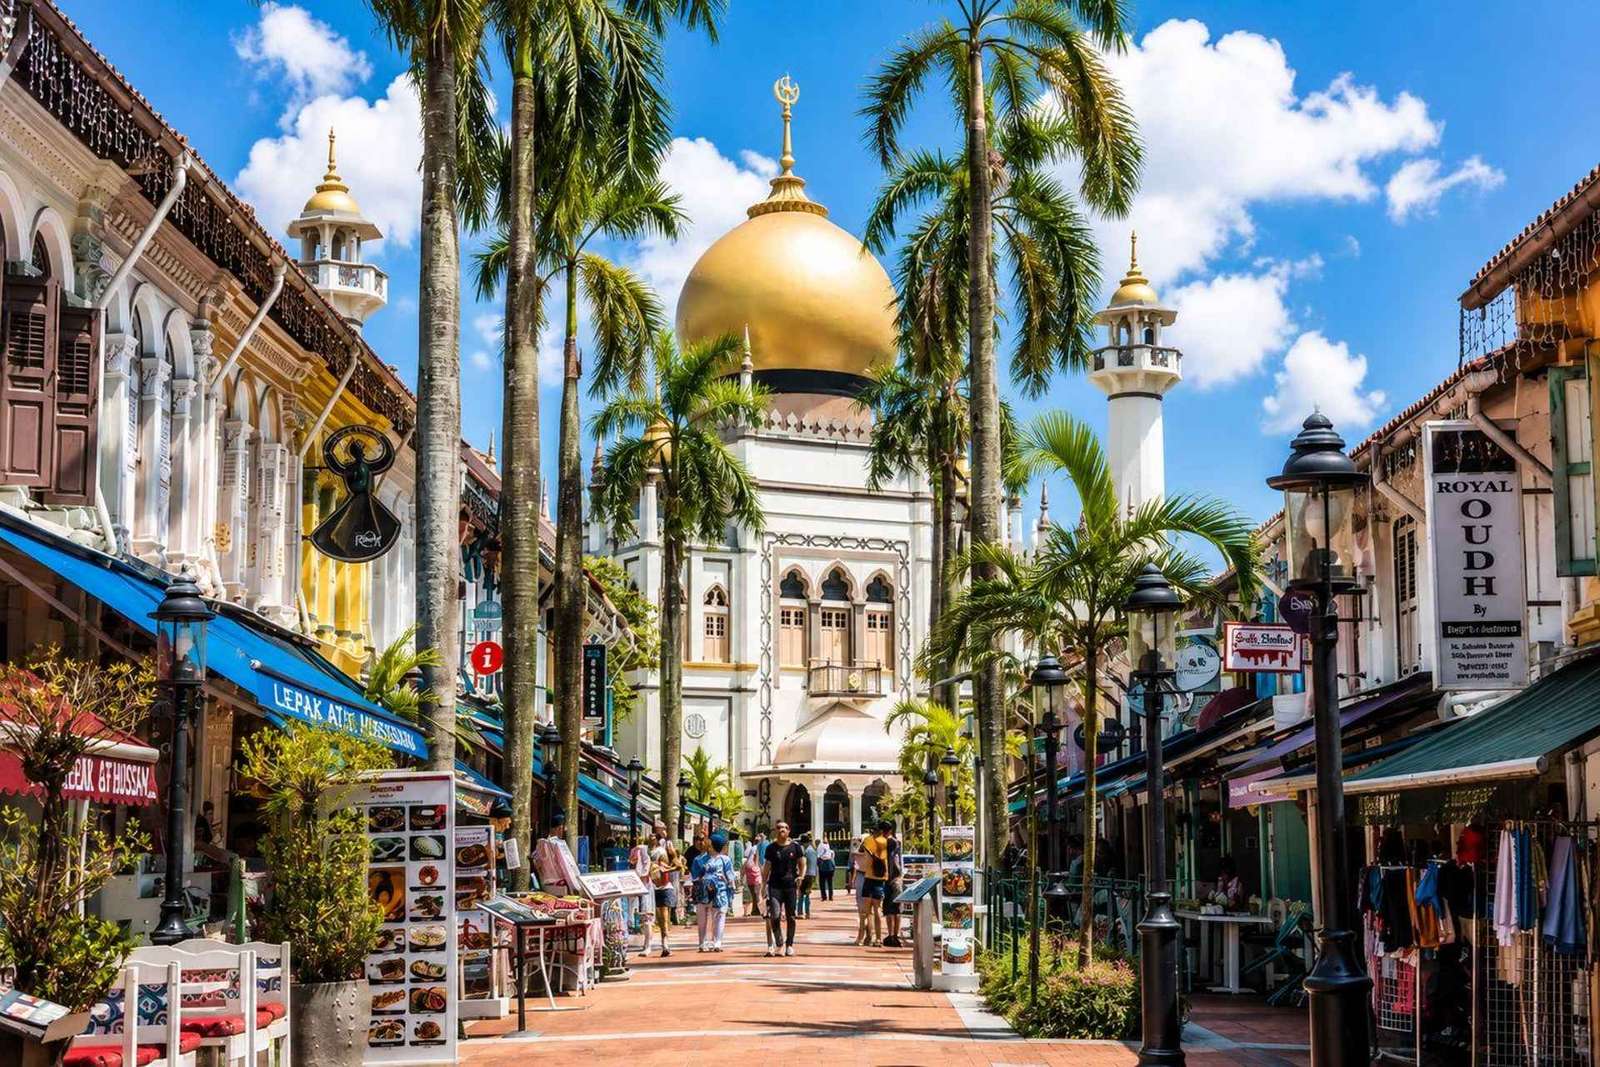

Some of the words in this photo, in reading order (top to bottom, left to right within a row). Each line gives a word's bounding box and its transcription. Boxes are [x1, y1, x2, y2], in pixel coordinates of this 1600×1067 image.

[1437, 481, 1513, 493] ROYAL
[1460, 498, 1498, 597] OUDH
[1473, 604, 1487, 617] By
[274, 683, 323, 721] LEPAK
